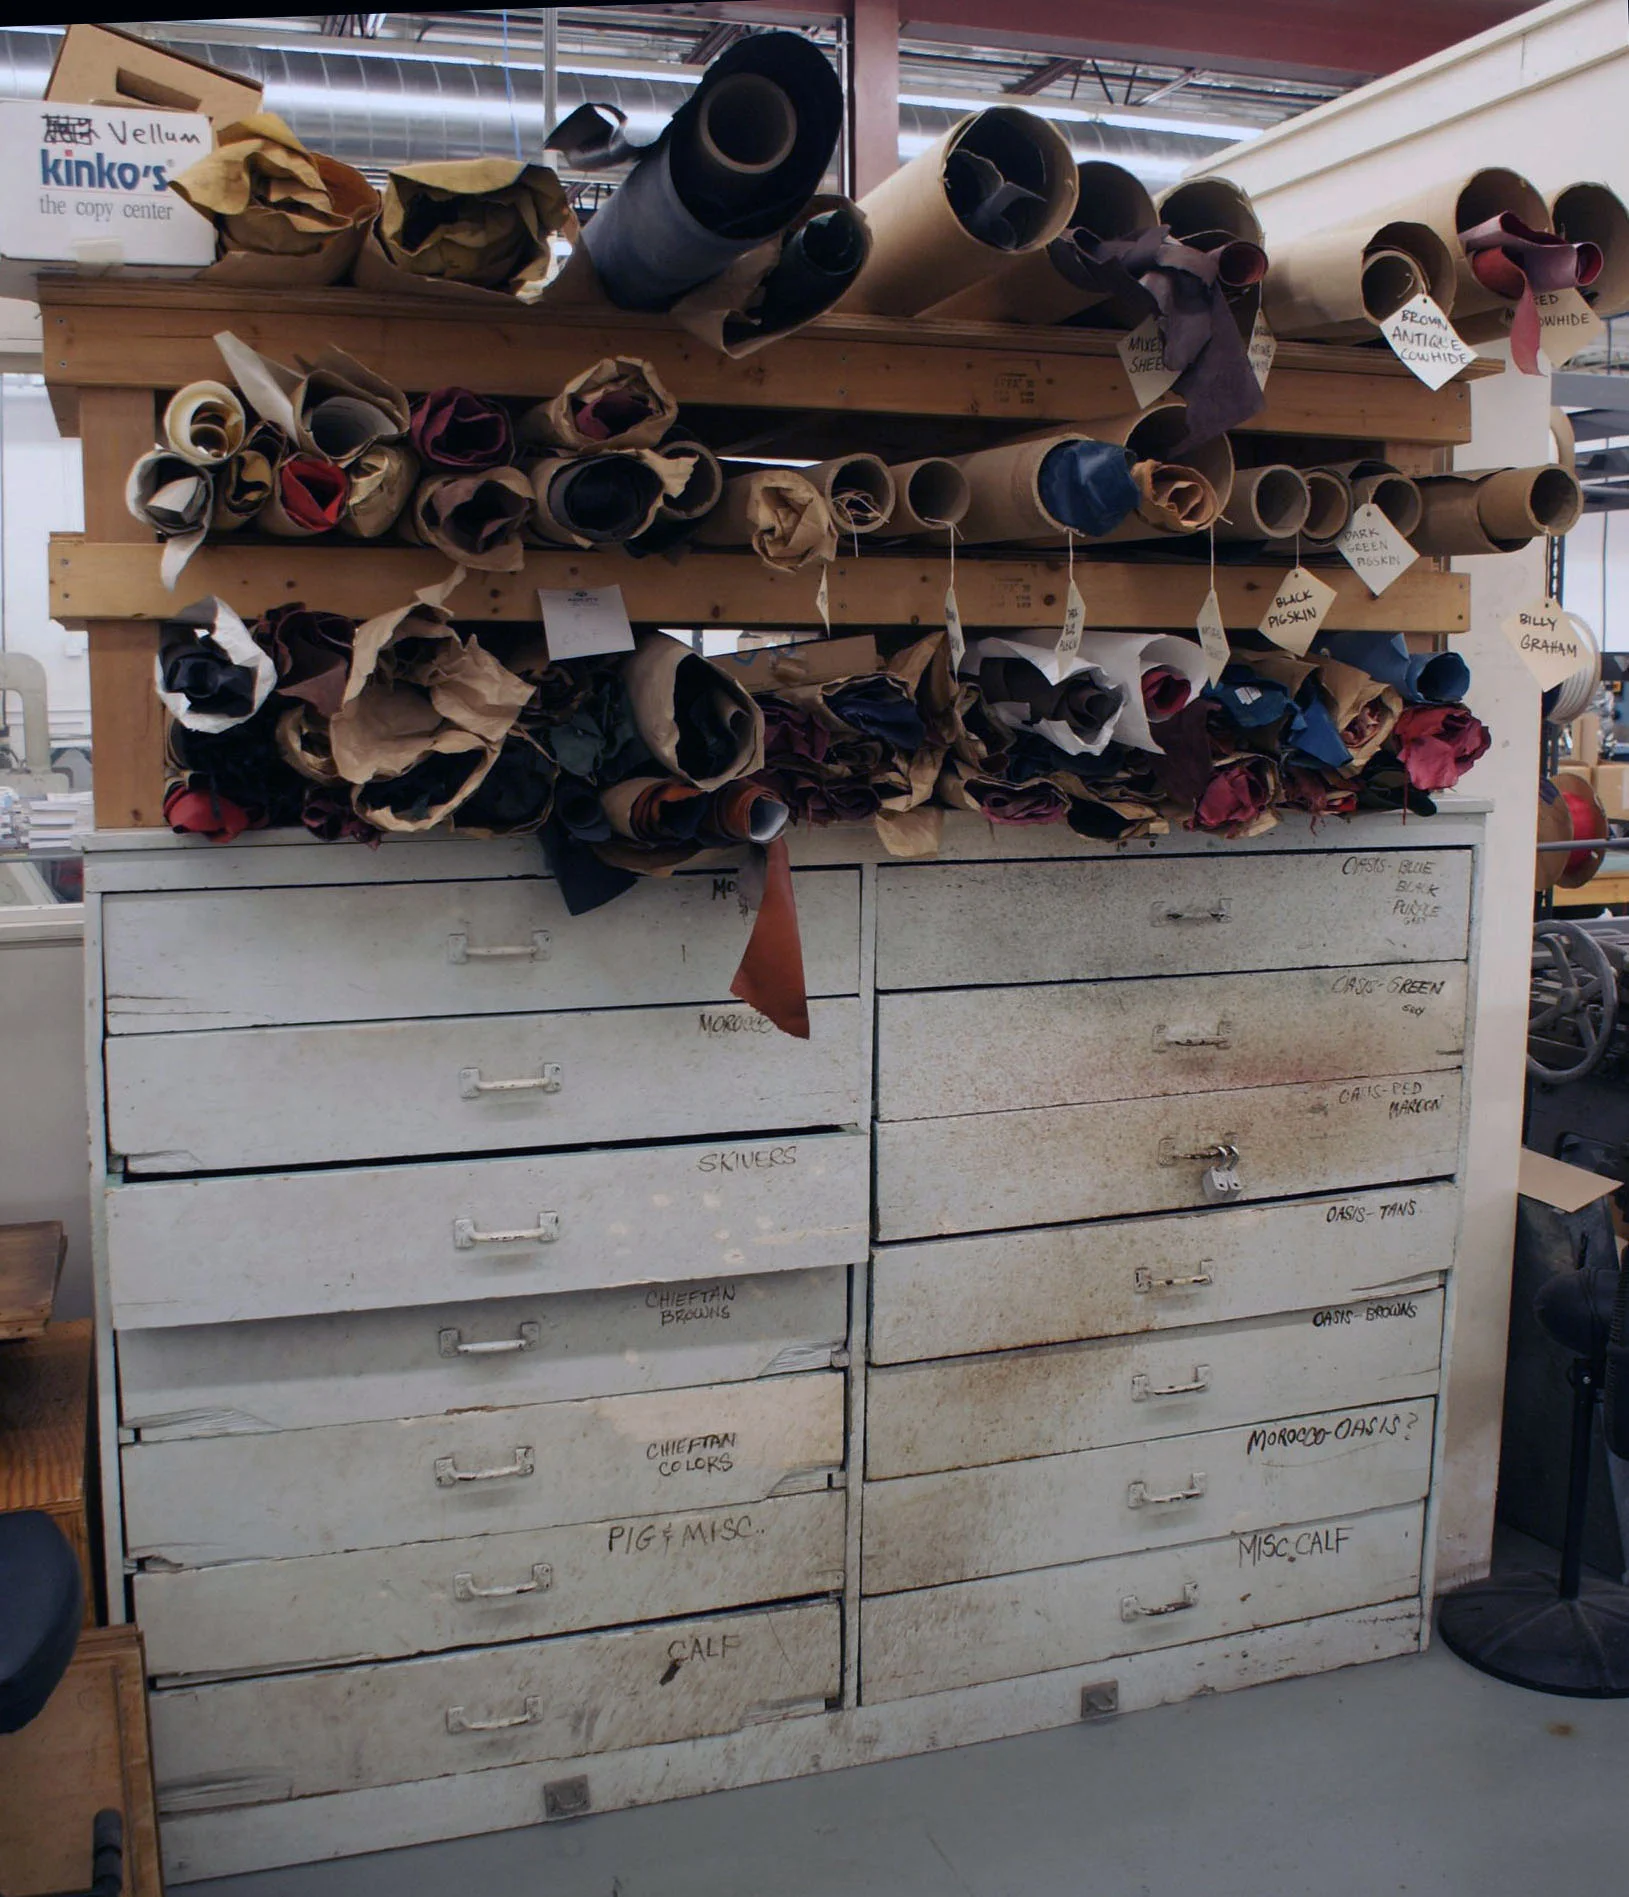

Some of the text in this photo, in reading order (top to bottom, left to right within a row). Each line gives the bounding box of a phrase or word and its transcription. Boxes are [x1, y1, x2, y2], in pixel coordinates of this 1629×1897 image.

[108, 121, 201, 145] Vellum
[40, 149, 167, 191] kinko's
[40, 194, 174, 222] the copy center
[1401, 309, 1448, 331] BROWN
[1392, 326, 1462, 352] ANTIQUE
[1400, 348, 1469, 365] COWHIDE
[1344, 527, 1379, 542] DARK
[1347, 539, 1389, 553] GREEN
[1276, 590, 1313, 608] BLACK
[1268, 607, 1317, 628] PIGSKIN
[1520, 613, 1557, 632] BILLY
[1520, 634, 1577, 658] GRAHAM
[698, 1145, 798, 1173] SKIVERS
[1380, 1199, 1416, 1220] TANS
[661, 1304, 731, 1327] BROWNS
[659, 1452, 734, 1477] COLORS
[609, 1524, 656, 1553] PIG
[668, 1634, 742, 1663] CALF
